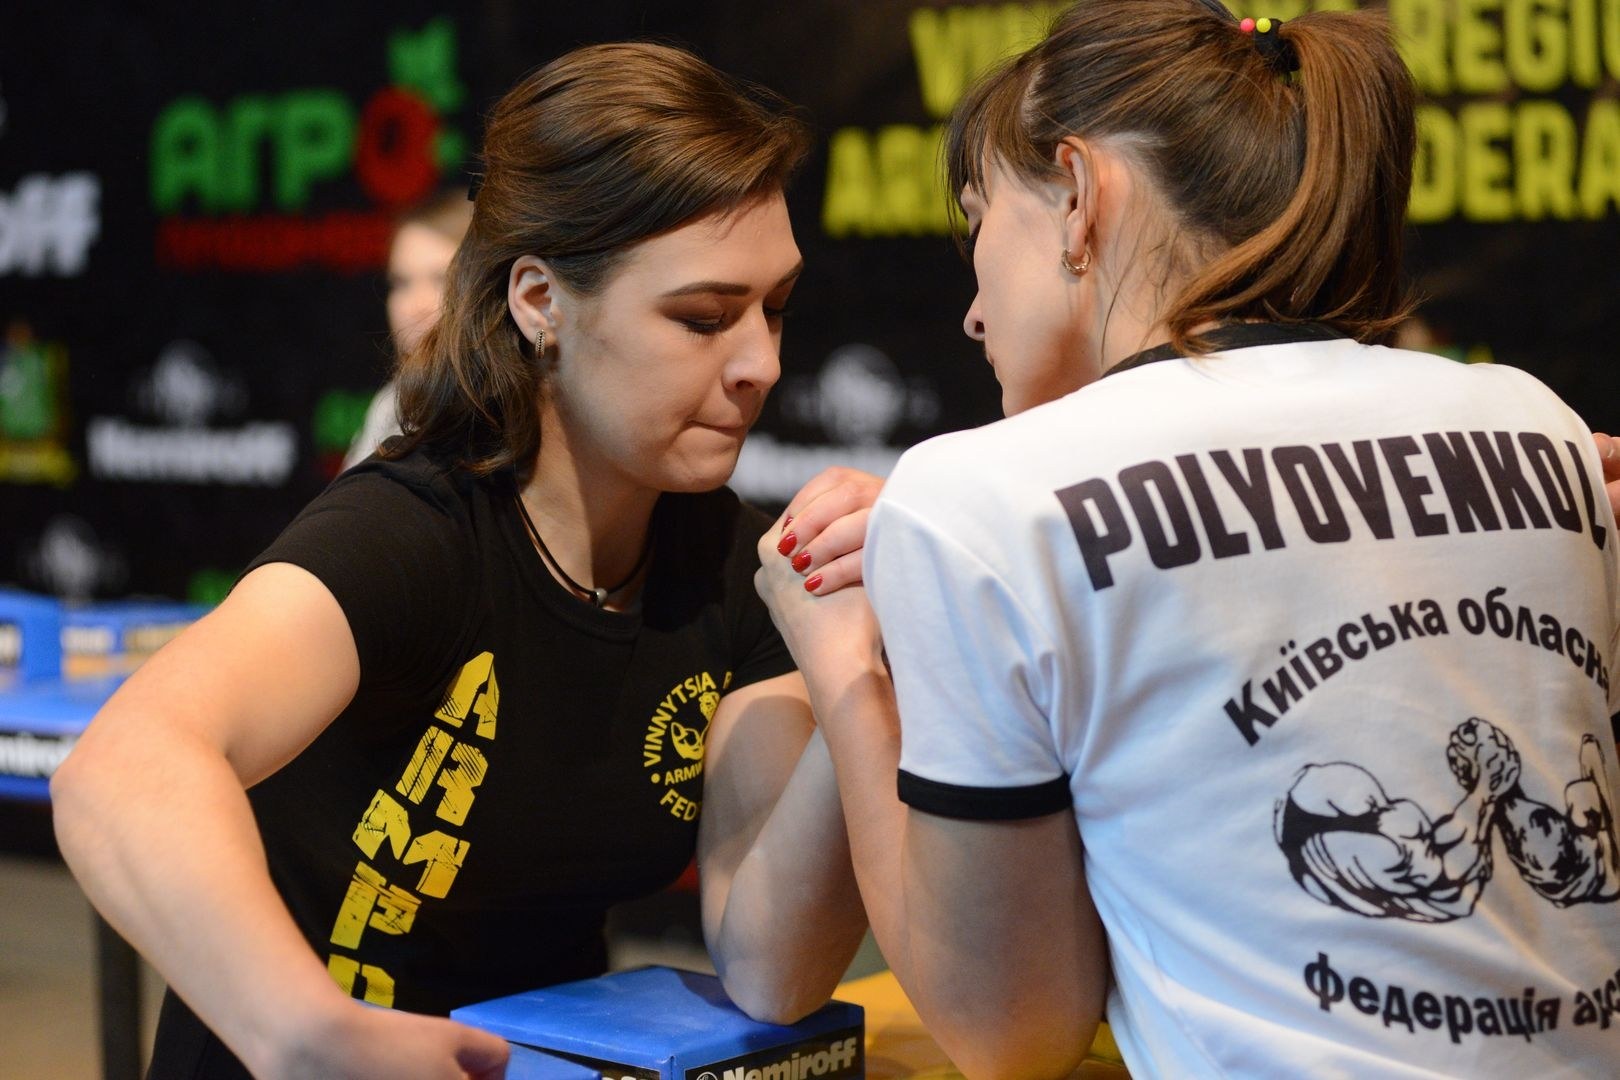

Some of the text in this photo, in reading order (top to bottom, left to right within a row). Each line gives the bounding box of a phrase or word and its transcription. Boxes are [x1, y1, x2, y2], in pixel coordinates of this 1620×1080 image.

[643, 671, 717, 767] VINNYTSIA
[1223, 598, 1449, 747] Київська
[1303, 952, 1561, 1044] Федерація
[722, 1036, 857, 1080] Nemiroff
